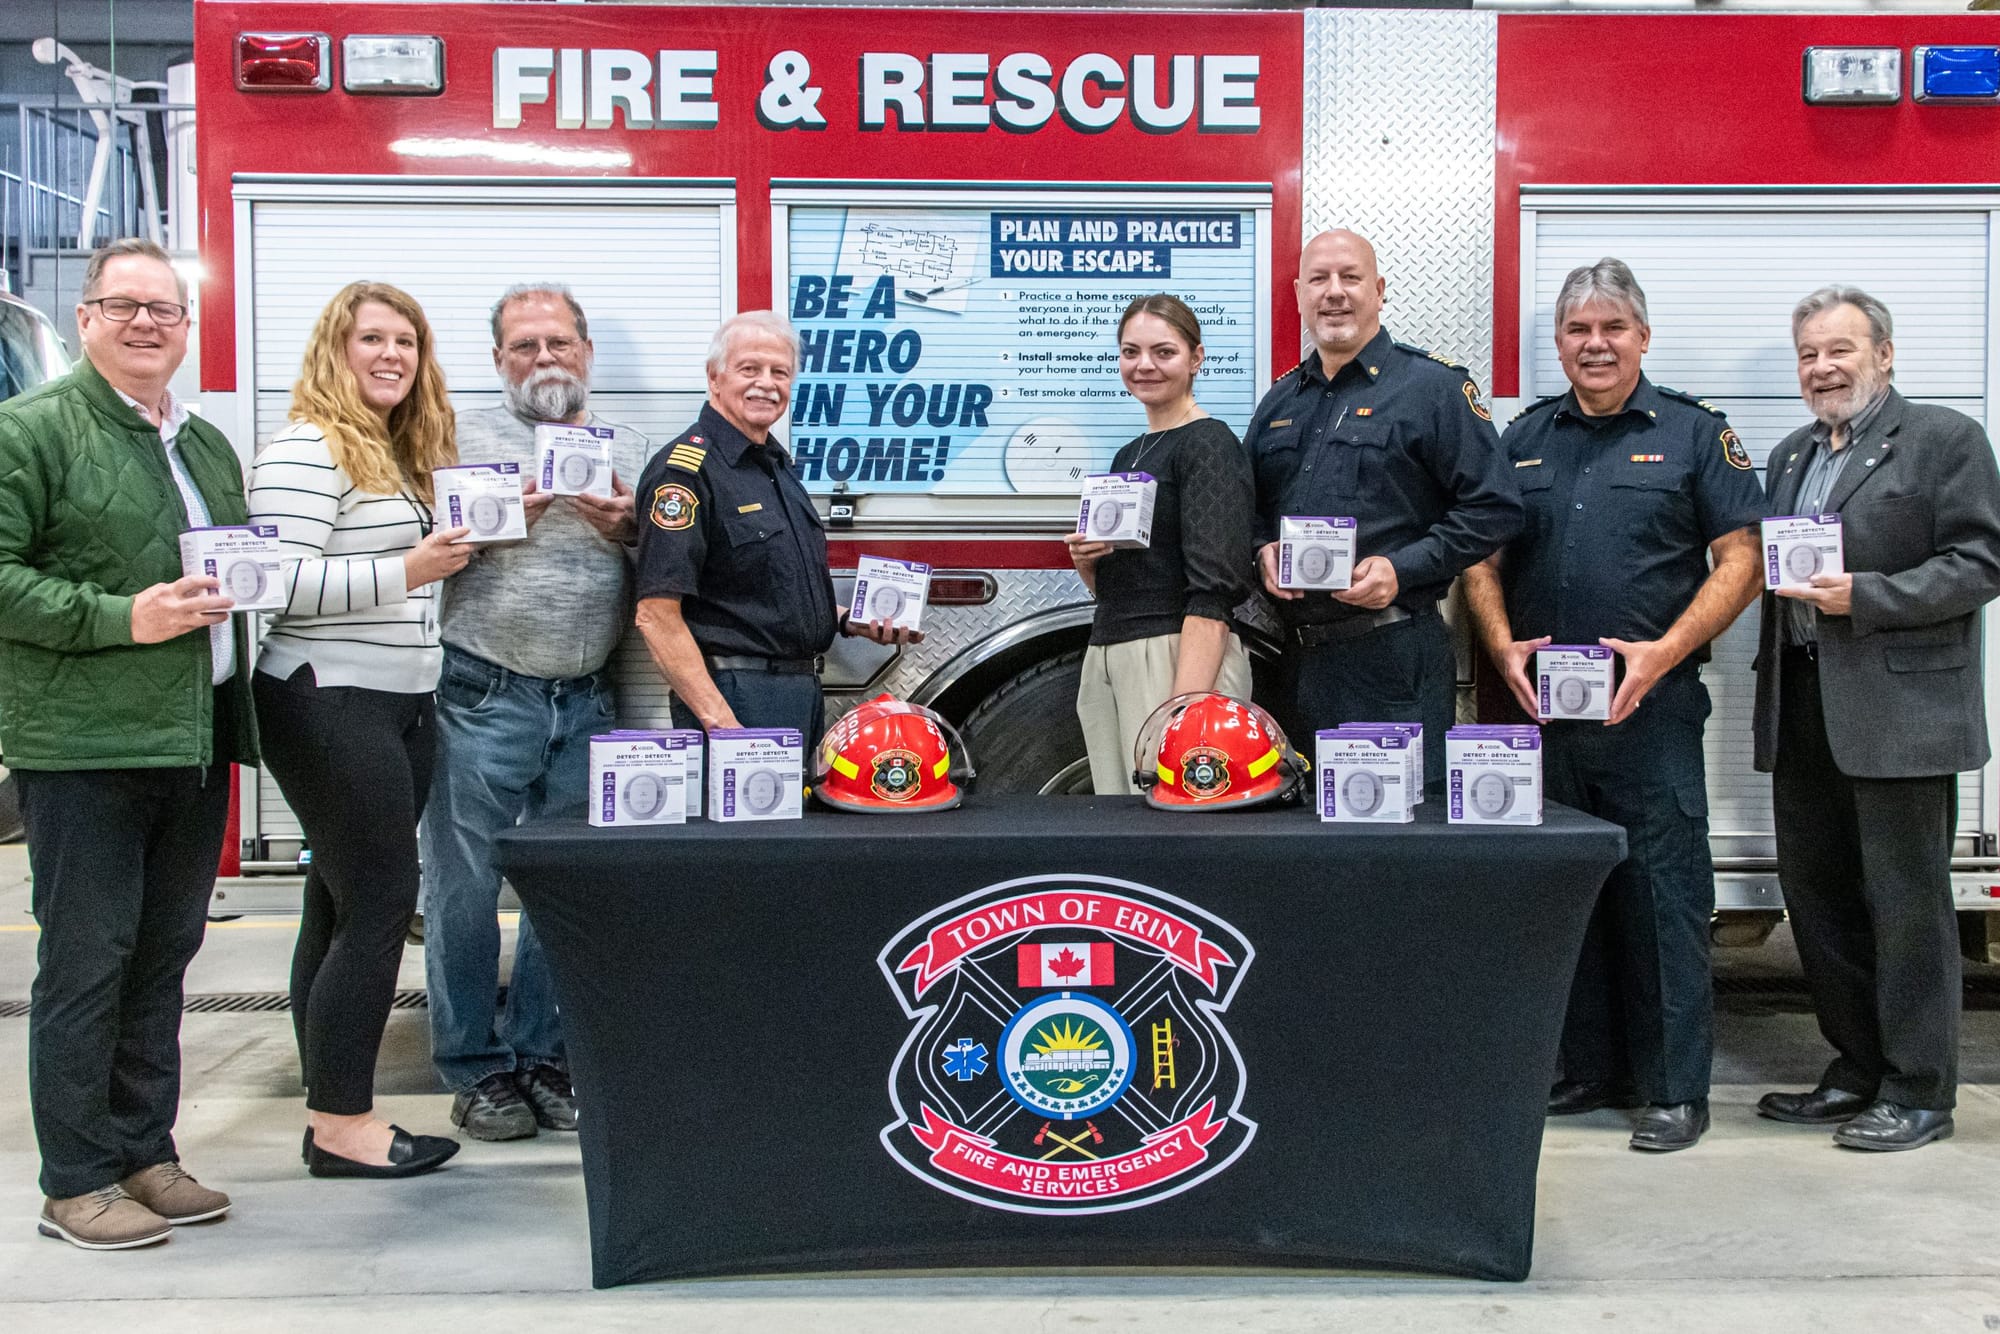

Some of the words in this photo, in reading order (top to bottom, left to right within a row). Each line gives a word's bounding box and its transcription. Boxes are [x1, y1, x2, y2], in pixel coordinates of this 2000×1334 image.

[493, 47, 719, 129] FIRE
[755, 50, 827, 131] &
[858, 52, 1261, 134] RESCUE
[1000, 220, 1060, 243] PLAN
[1068, 221, 1119, 243] AND
[1127, 221, 1234, 244] PRACTICE
[1000, 249, 1065, 273] YOUR
[1073, 249, 1163, 273] ESCAPE.
[792, 275, 853, 319] BE
[862, 275, 897, 319] A
[1003, 292, 1008, 300] 1
[1019, 291, 1062, 301] Practice
[1076, 291, 1109, 301] home
[1018, 306, 1070, 315] everyone
[1073, 304, 1083, 313] in
[1087, 306, 1112, 315] your
[1191, 304, 1226, 316] xactly
[1018, 315, 1046, 325] what
[1049, 317, 1060, 325] to
[1063, 315, 1079, 325] do
[1082, 315, 1090, 325] if
[1092, 315, 1109, 325] the
[1227, 317, 1237, 326] in
[1018, 330, 1033, 338] an
[1036, 330, 1100, 340] emergency.
[799, 329, 922, 374] HERO
[1002, 353, 1009, 361] 2
[1018, 352, 1053, 362] Install
[1056, 352, 1094, 362] smoke
[1227, 352, 1239, 362] of
[1018, 367, 1043, 376] your
[1046, 364, 1077, 374] home
[1081, 364, 1102, 374] and
[1213, 367, 1247, 375] areas.
[1002, 388, 1008, 396] 3
[1018, 387, 1039, 397] Test
[1042, 387, 1076, 397] smoke
[1080, 387, 1117, 397] alarms
[792, 383, 847, 427] IN
[866, 382, 993, 428] YOUR
[795, 435, 951, 482] HOME!
[947, 900, 1046, 949] TOWN
[1059, 899, 1101, 922] OF
[1115, 906, 1183, 949] ERIN
[952, 1142, 997, 1170] FIRE
[1001, 1161, 1050, 1180] AND
[1058, 1136, 1184, 1181] EMERGENCY
[1021, 1177, 1120, 1195] SERVICES
